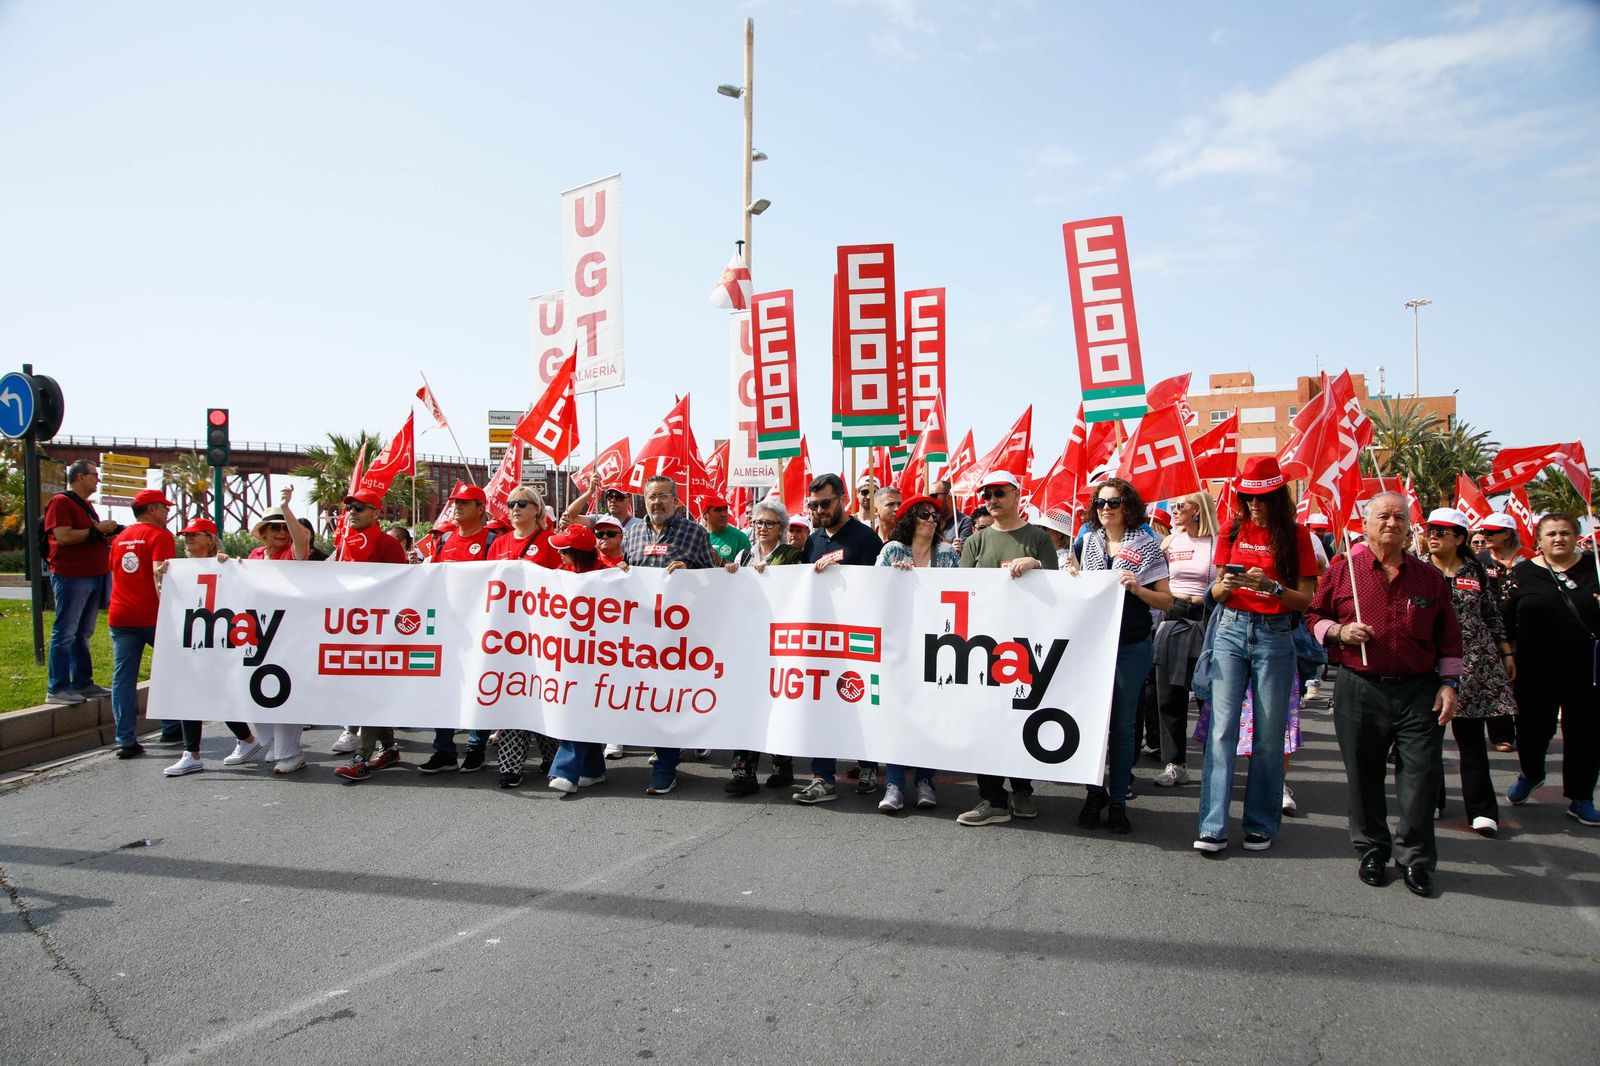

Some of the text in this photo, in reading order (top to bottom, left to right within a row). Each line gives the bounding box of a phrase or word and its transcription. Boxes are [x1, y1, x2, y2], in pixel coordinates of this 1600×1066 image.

[574, 189, 608, 358] UGT
[1073, 223, 1132, 384] CCOO
[847, 252, 888, 411] CCOO
[758, 296, 792, 429] CCOO
[733, 464, 775, 478] ALMERÍA
[323, 607, 390, 636] UGT
[485, 580, 690, 632] Proteger lo
[324, 650, 404, 670] CCOO
[481, 629, 724, 679] conquistado,
[774, 629, 844, 652] CCOO
[476, 670, 717, 714] ganar futuro
[769, 667, 829, 701] UGT
